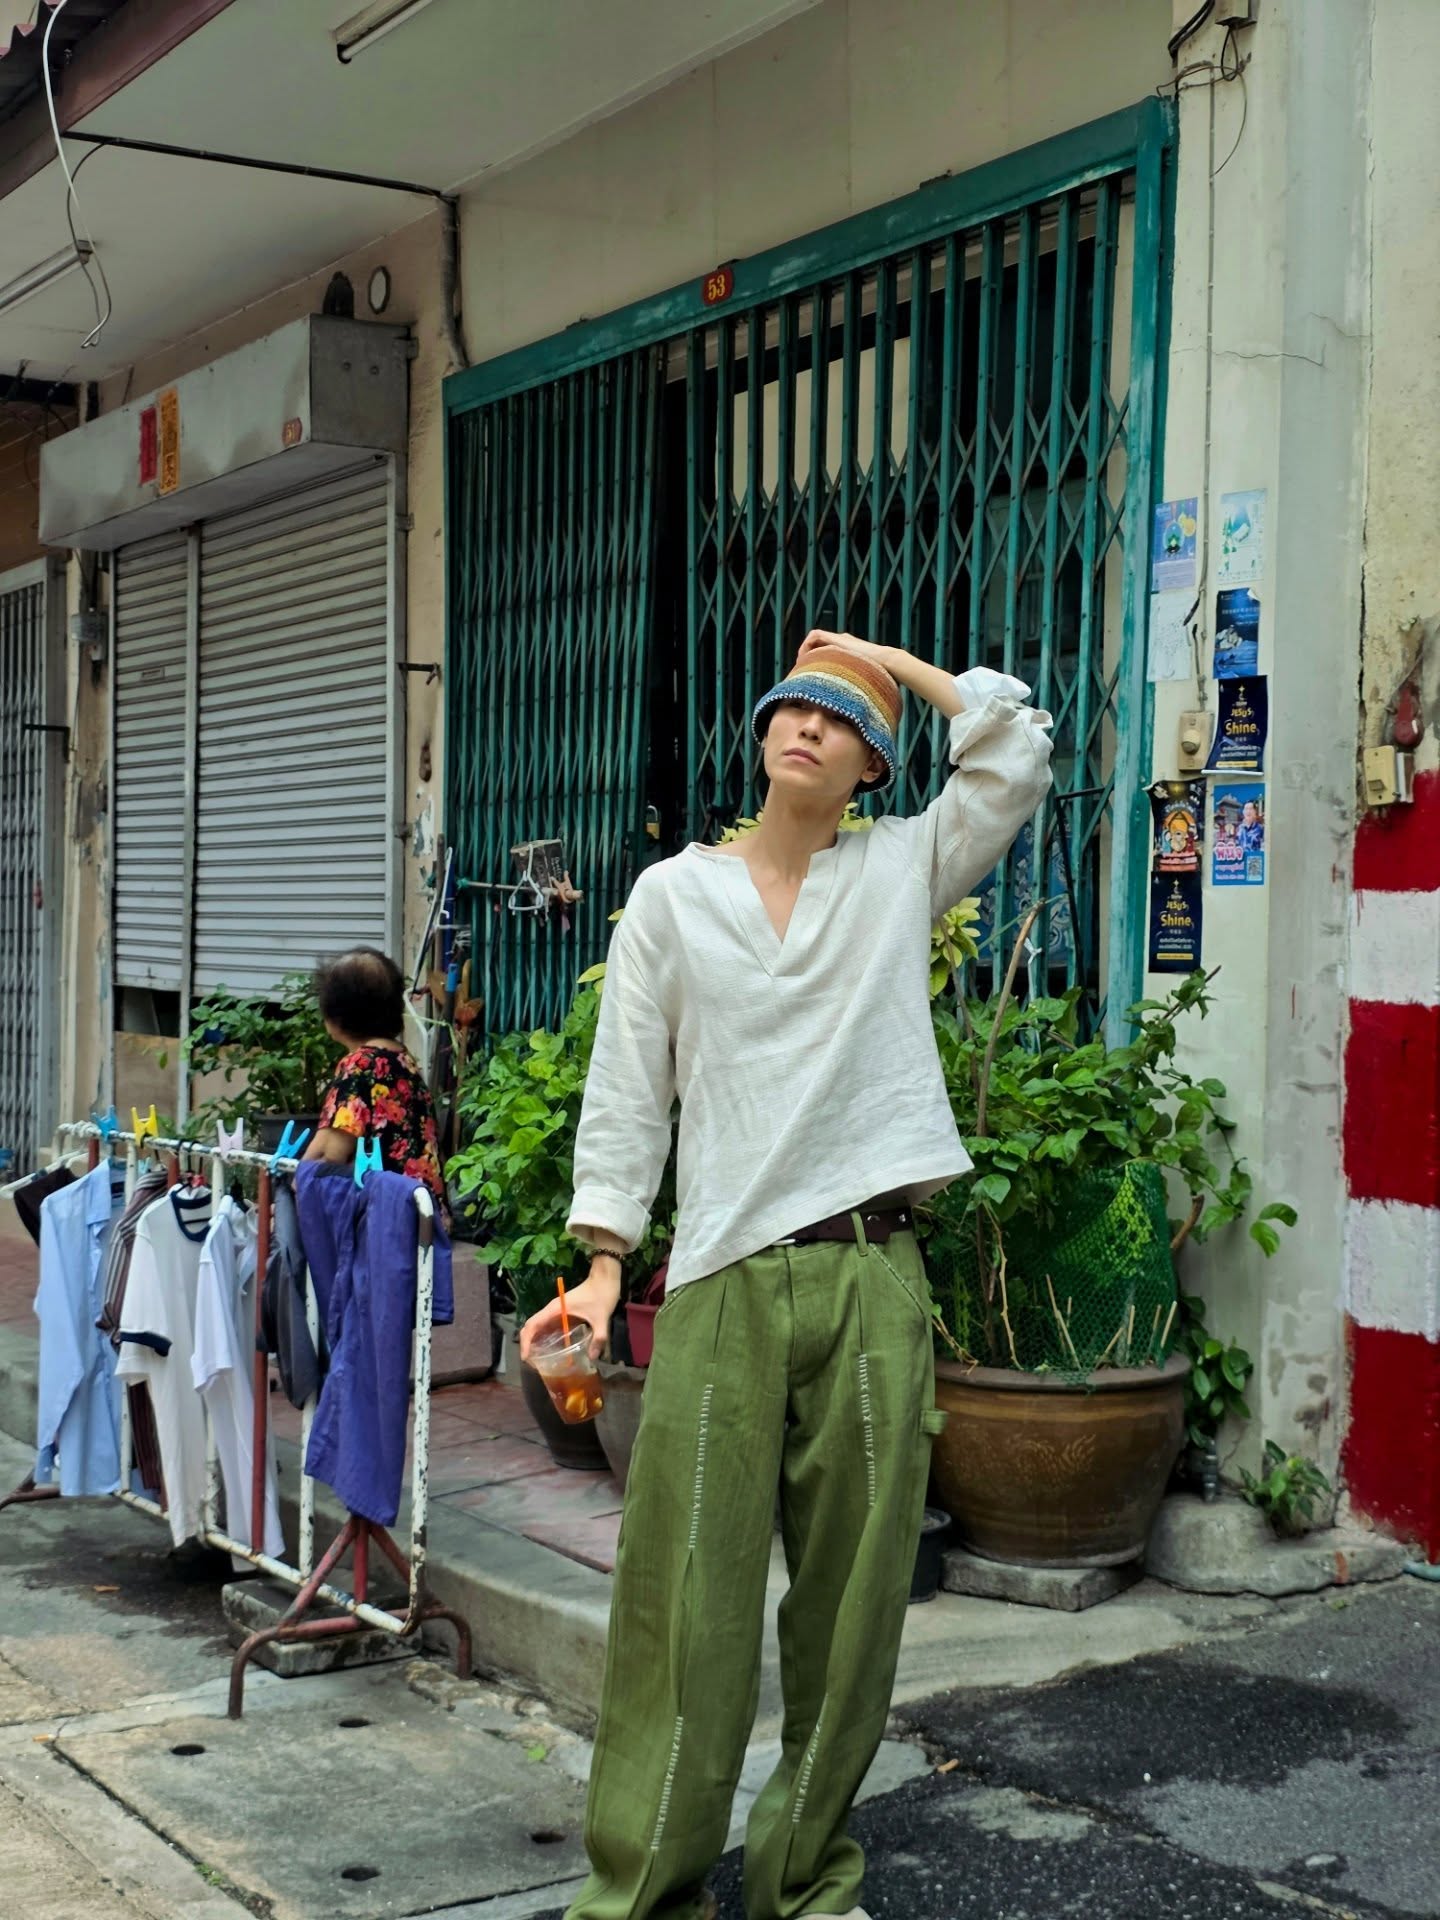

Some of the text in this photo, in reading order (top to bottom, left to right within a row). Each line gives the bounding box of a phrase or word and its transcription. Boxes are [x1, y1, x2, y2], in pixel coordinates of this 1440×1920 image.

[707, 274, 726, 301] 53
[1225, 720, 1256, 735] Shine
[1160, 912, 1192, 927] Shine
